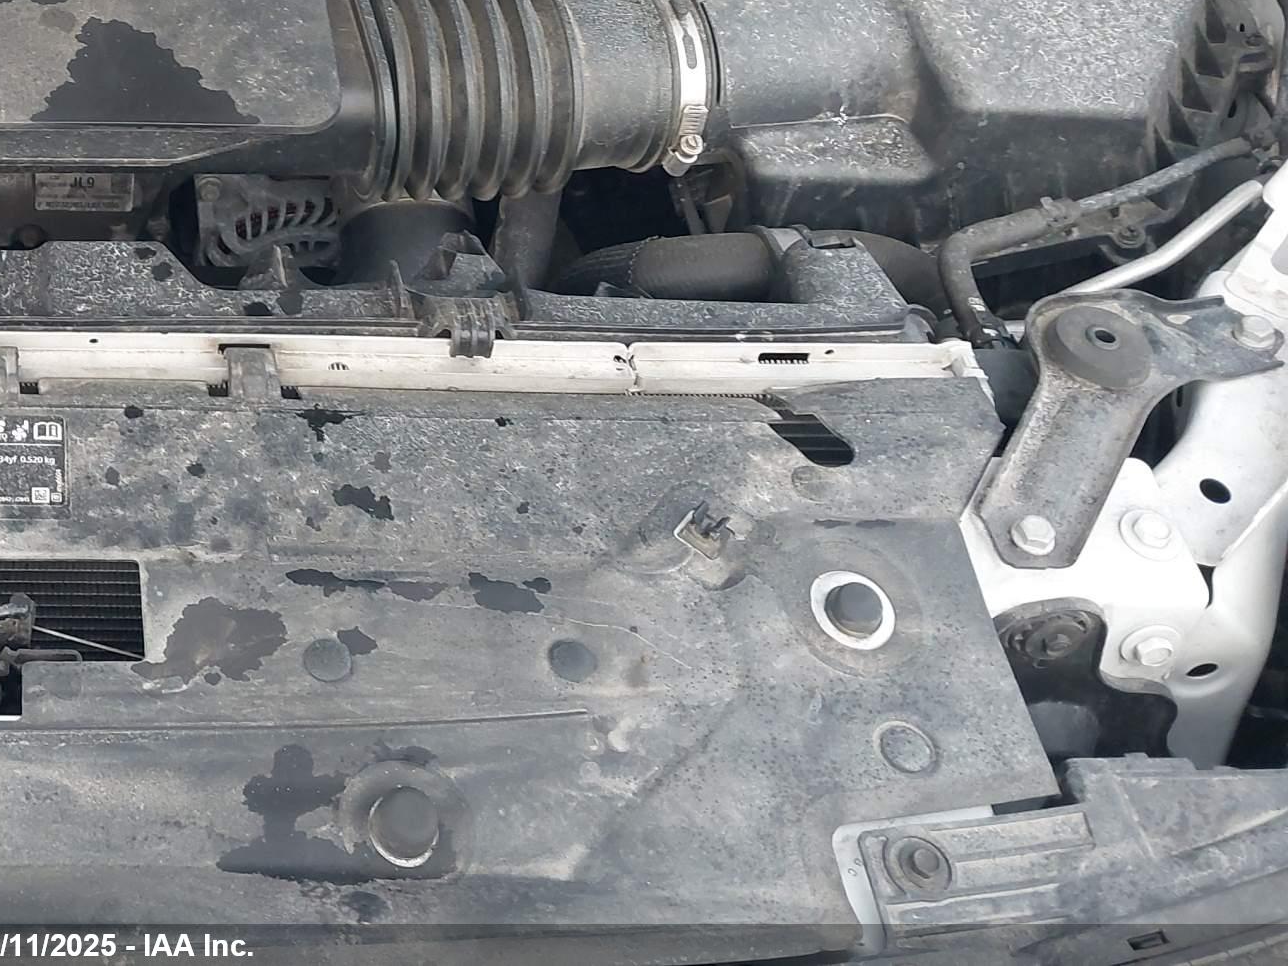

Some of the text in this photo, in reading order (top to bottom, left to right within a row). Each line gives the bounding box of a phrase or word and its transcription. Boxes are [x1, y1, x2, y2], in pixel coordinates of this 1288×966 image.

[70, 176, 95, 188] JL9
[21, 455, 43, 464] 0.520
[44, 455, 56, 466] kg
